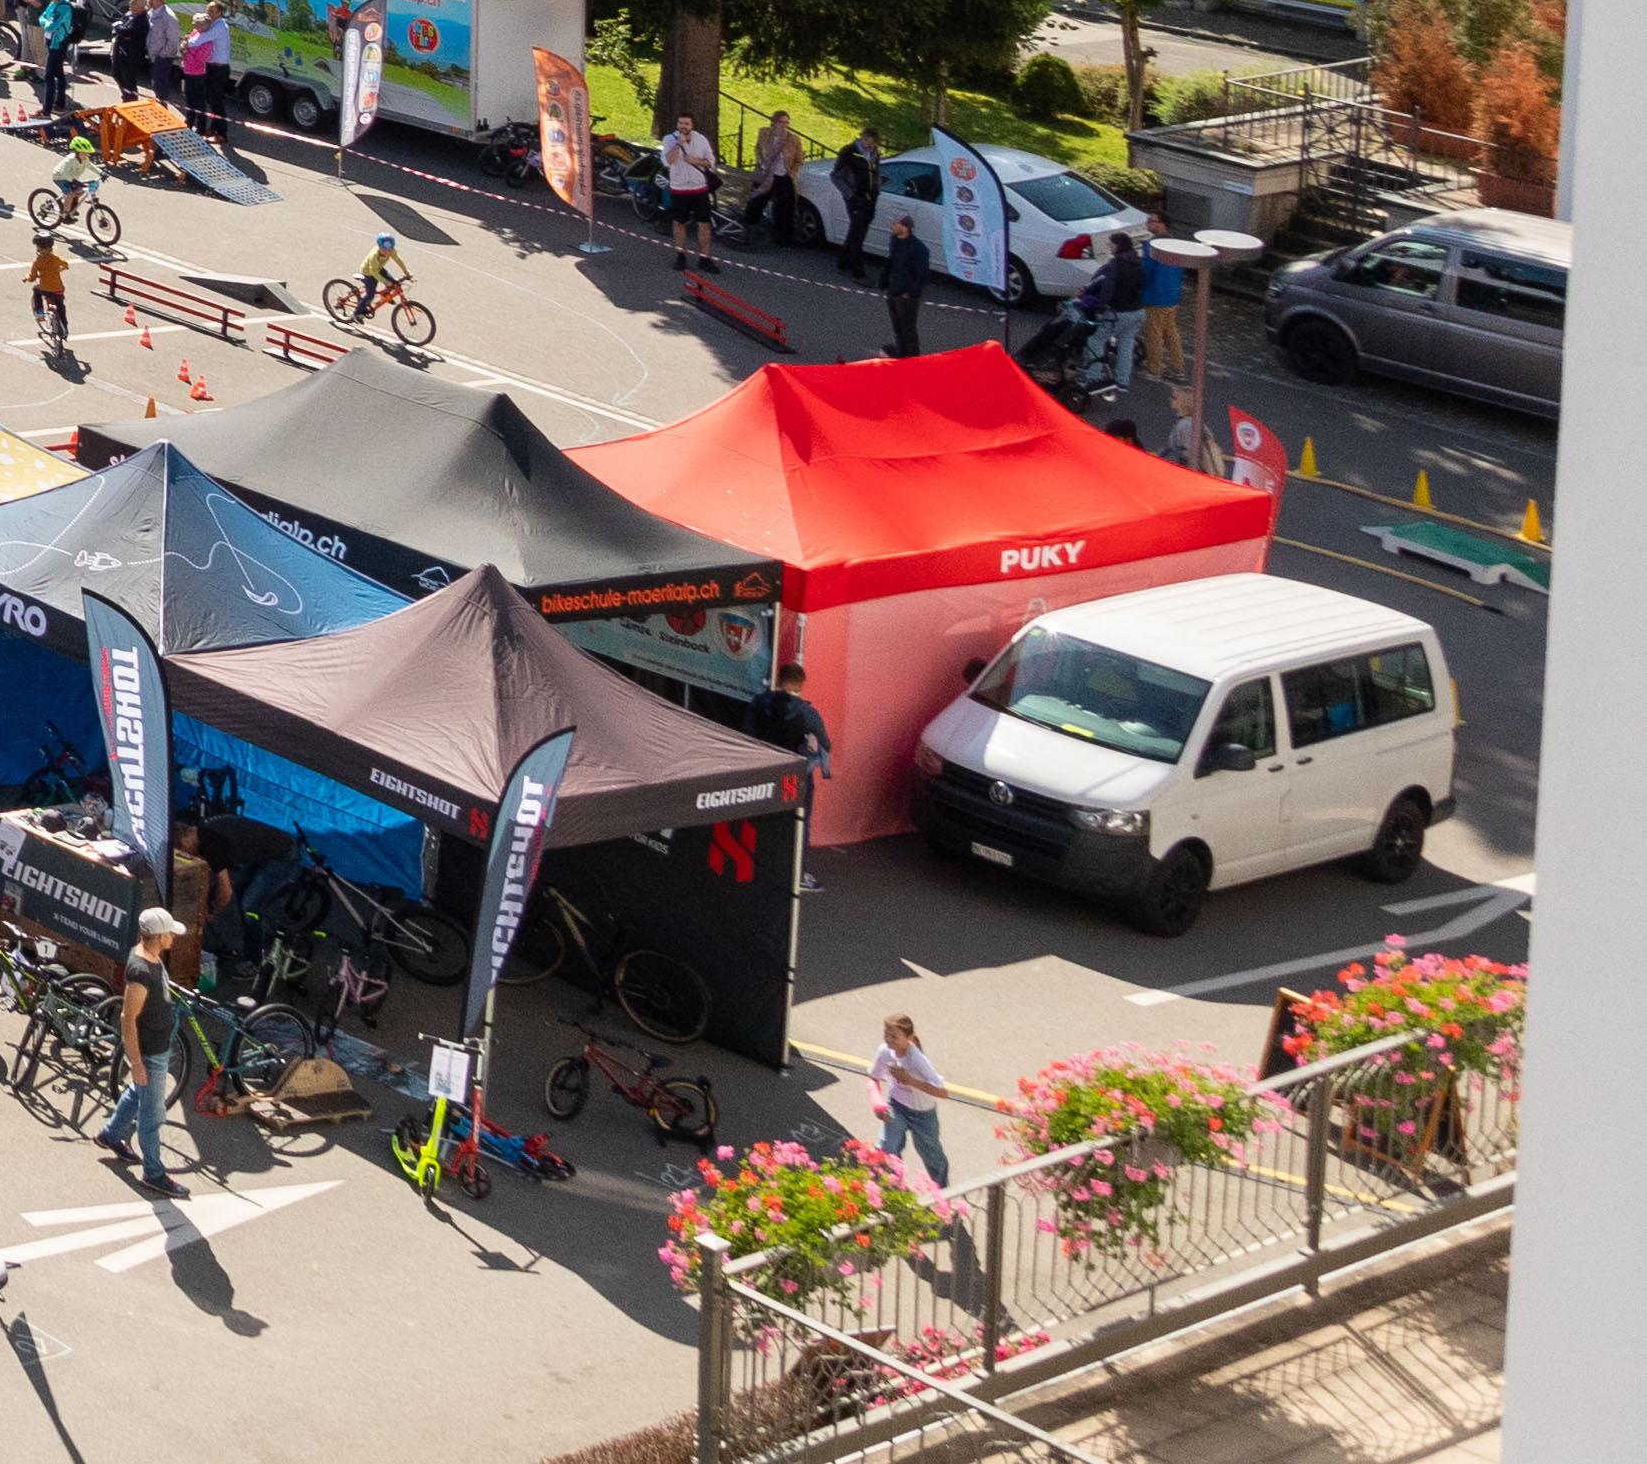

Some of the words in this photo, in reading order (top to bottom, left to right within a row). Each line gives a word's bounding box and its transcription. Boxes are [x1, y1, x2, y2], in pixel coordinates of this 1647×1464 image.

[1000, 540, 1086, 573] PUKY
[369, 767, 461, 820] EIGHTSHOT
[696, 782, 775, 810] EIGHTSHOT
[648, 838, 669, 856] KIDS
